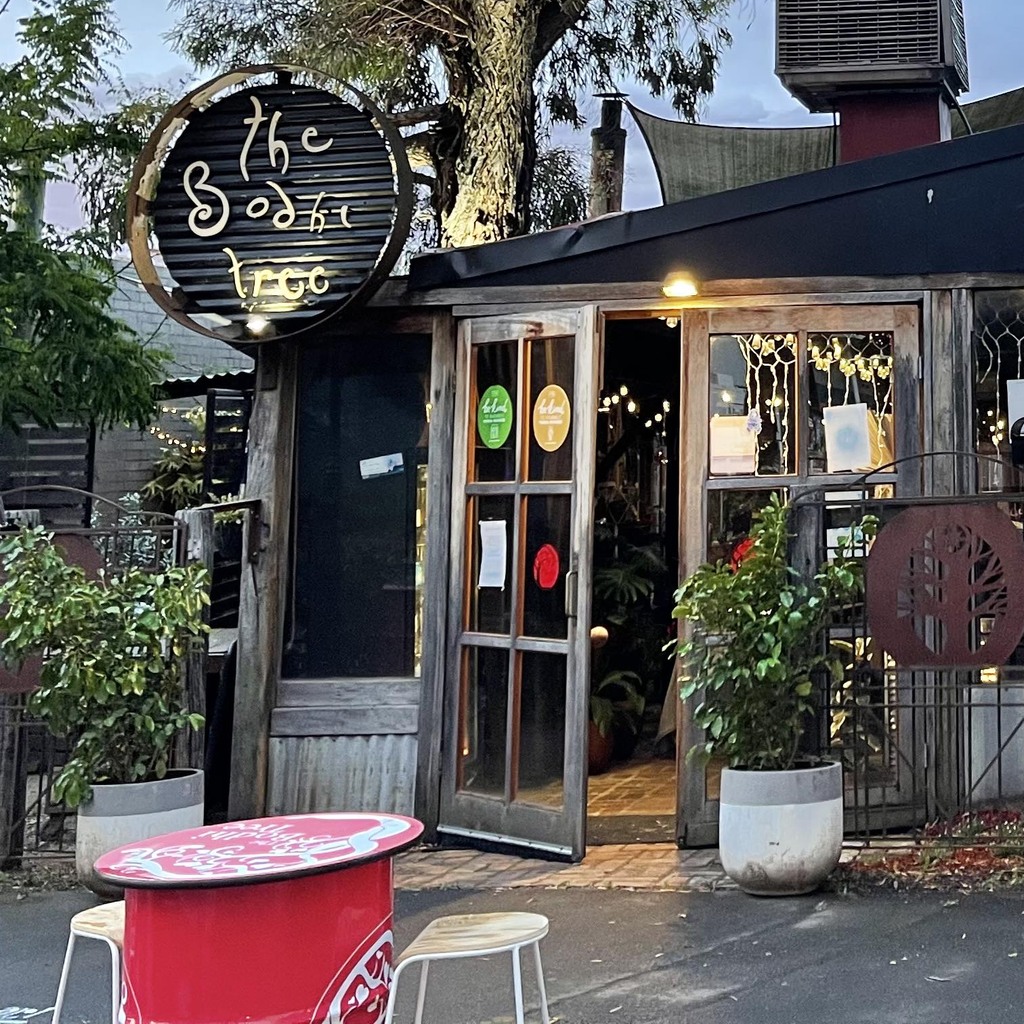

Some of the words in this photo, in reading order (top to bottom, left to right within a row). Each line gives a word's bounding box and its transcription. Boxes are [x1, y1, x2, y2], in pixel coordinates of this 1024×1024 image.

[239, 95, 334, 182] the
[183, 160, 353, 237] Bodhi
[222, 247, 330, 300] tree
